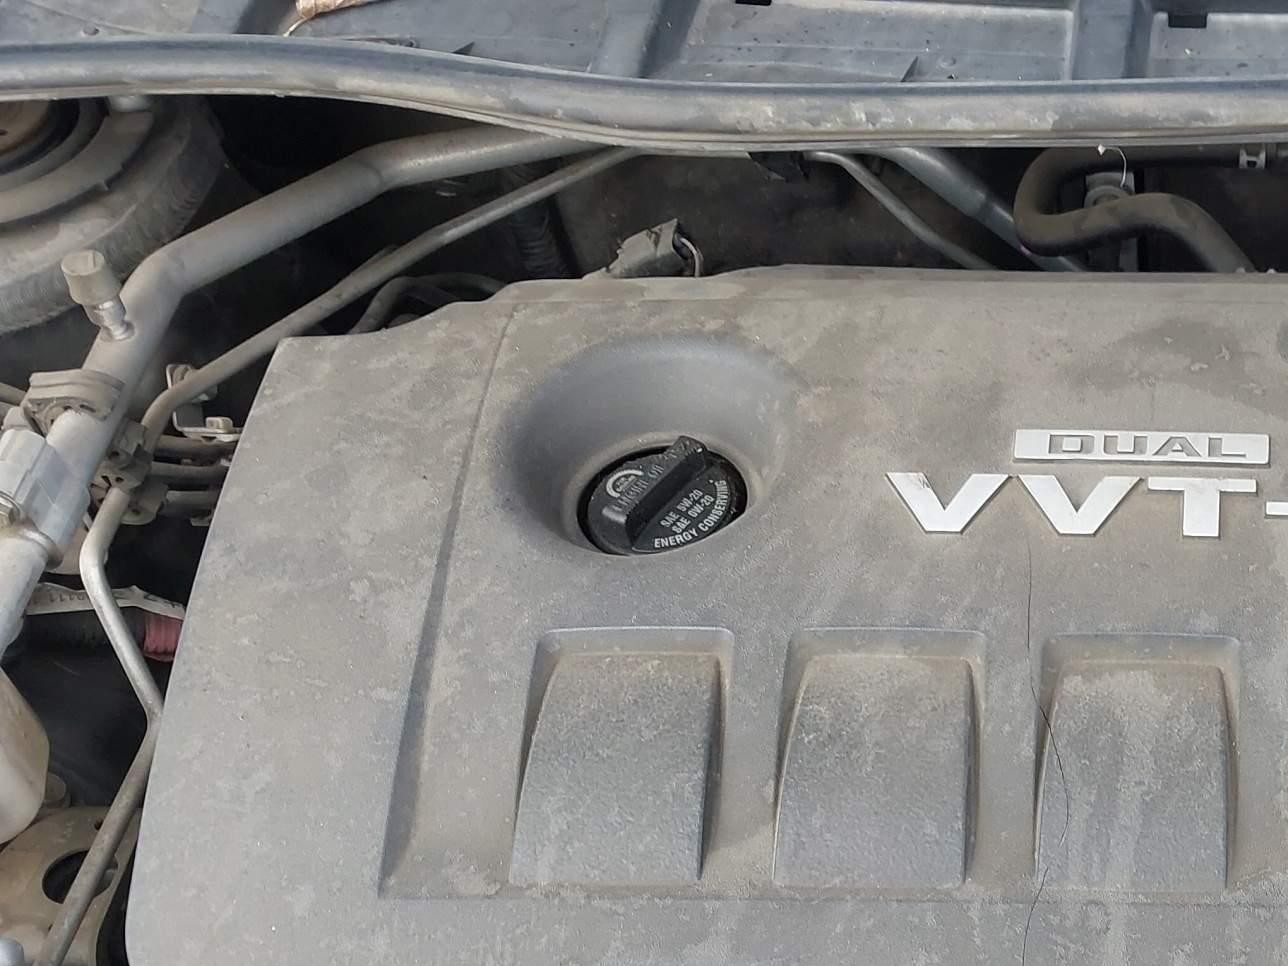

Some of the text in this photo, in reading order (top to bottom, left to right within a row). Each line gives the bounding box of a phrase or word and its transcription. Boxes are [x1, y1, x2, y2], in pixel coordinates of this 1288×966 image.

[1048, 433, 1247, 459] DUAL
[654, 479, 730, 548] ENERGY CONSERVING
[660, 488, 703, 528] SAE 5W-20
[672, 516, 691, 534] SAE
